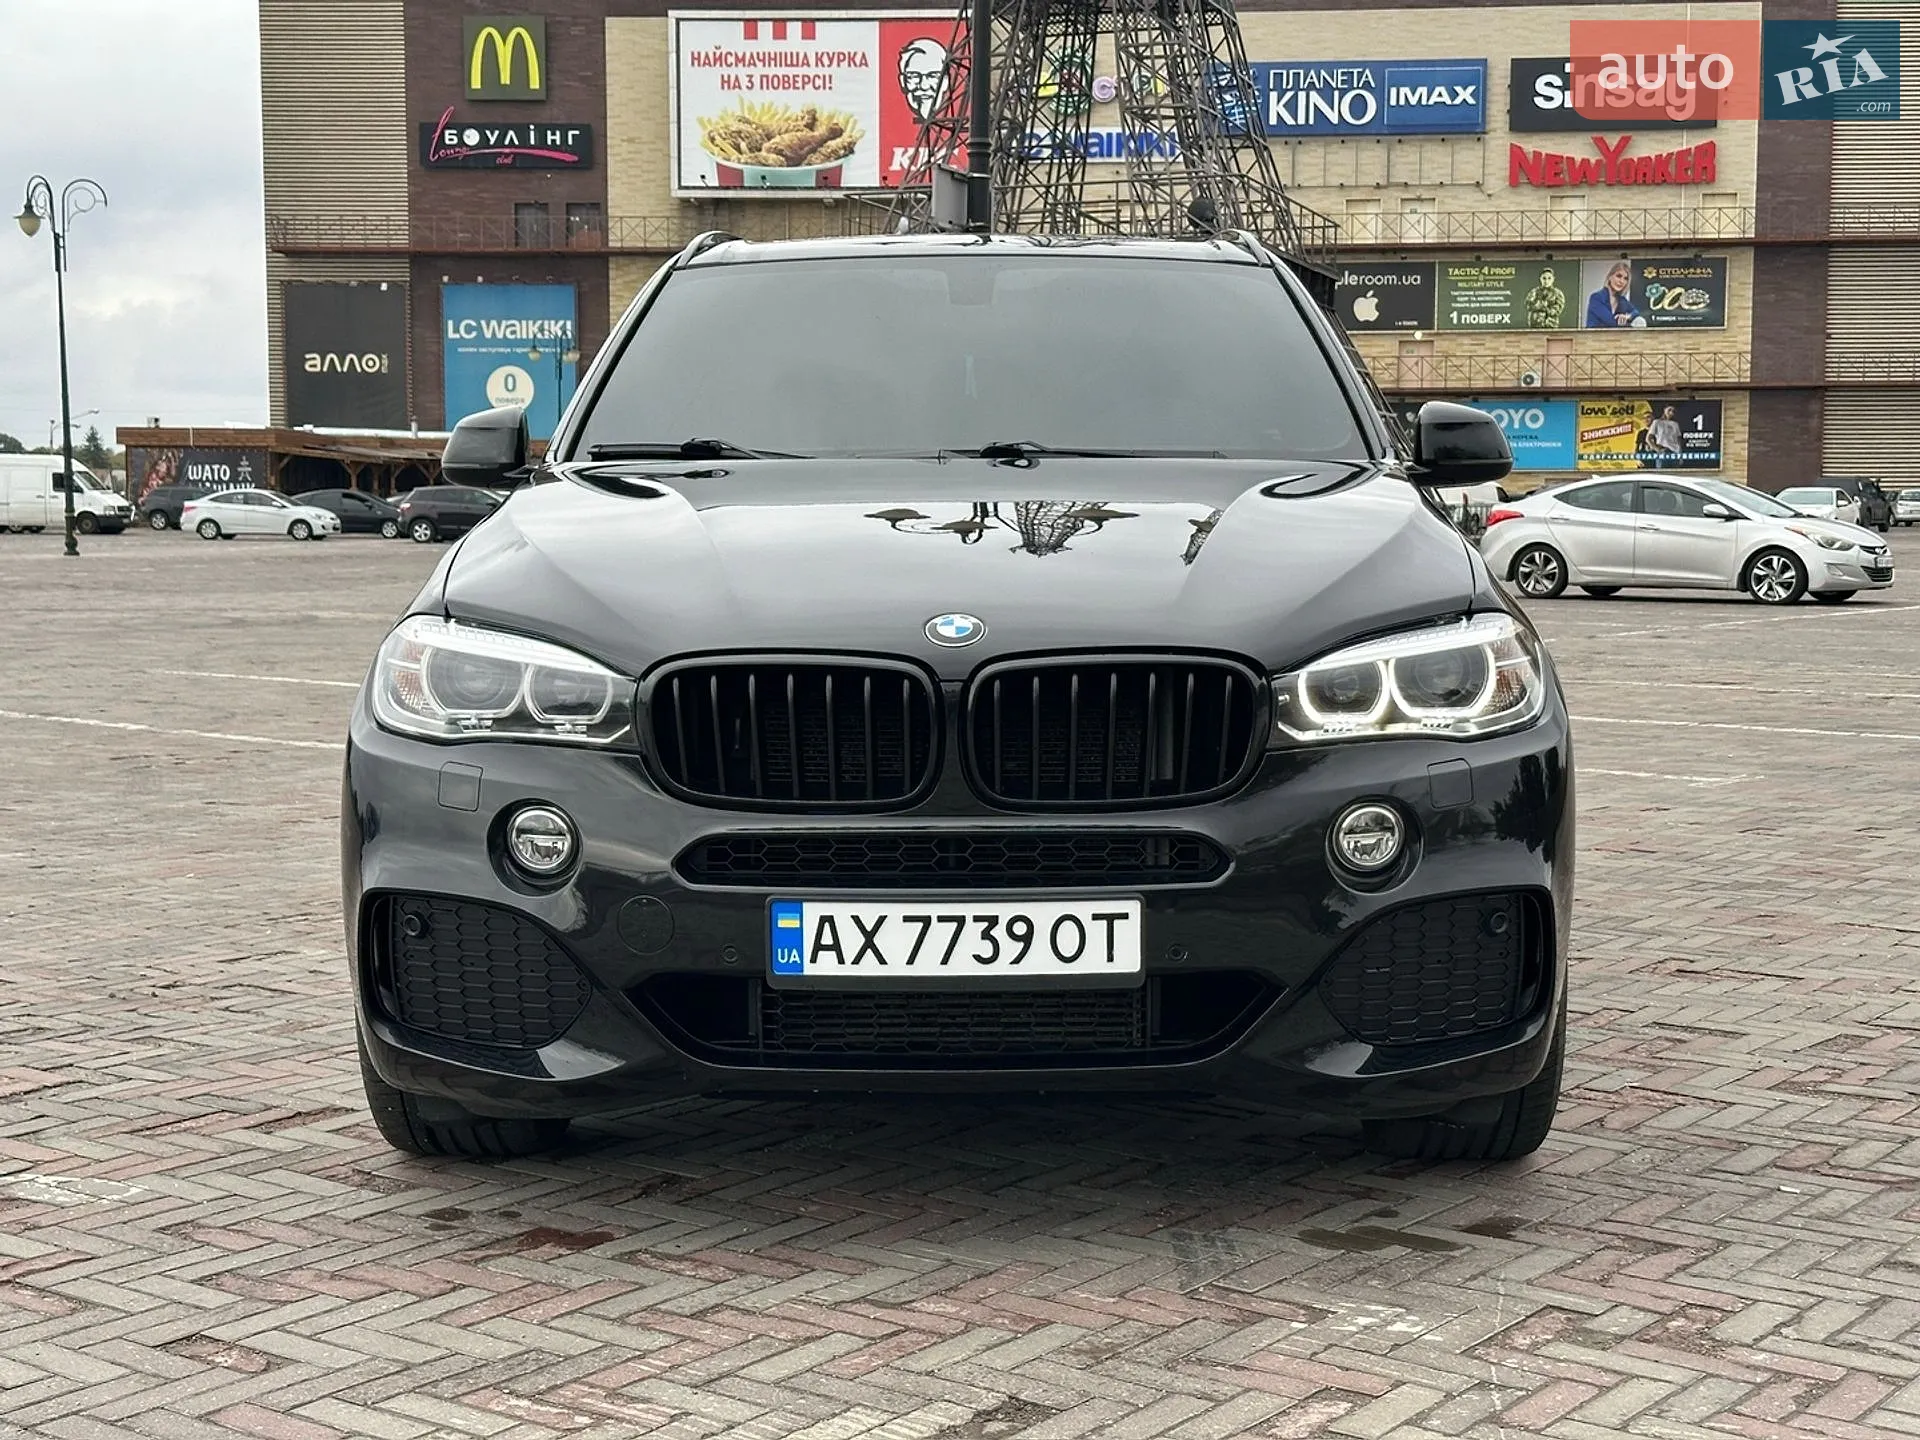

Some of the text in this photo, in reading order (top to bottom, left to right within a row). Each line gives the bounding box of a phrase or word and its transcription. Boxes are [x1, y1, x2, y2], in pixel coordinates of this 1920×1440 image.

[690, 45, 869, 68] НАЙСМАЧНІША КУРКА
[720, 74, 833, 91] НА 3 ПОВЕРСІ!
[1390, 85, 1477, 106] IMAX
[1268, 89, 1377, 126] KINO
[1448, 268, 1480, 276] TACTIC
[1481, 266, 1489, 275] 4
[1449, 310, 1511, 325] 1 ПОВЕРХ
[447, 319, 477, 339] LC
[503, 373, 517, 393] 0
[1692, 414, 1704, 431] 1
[809, 912, 1130, 966] AX 7739 OT
[777, 948, 801, 964] UA
